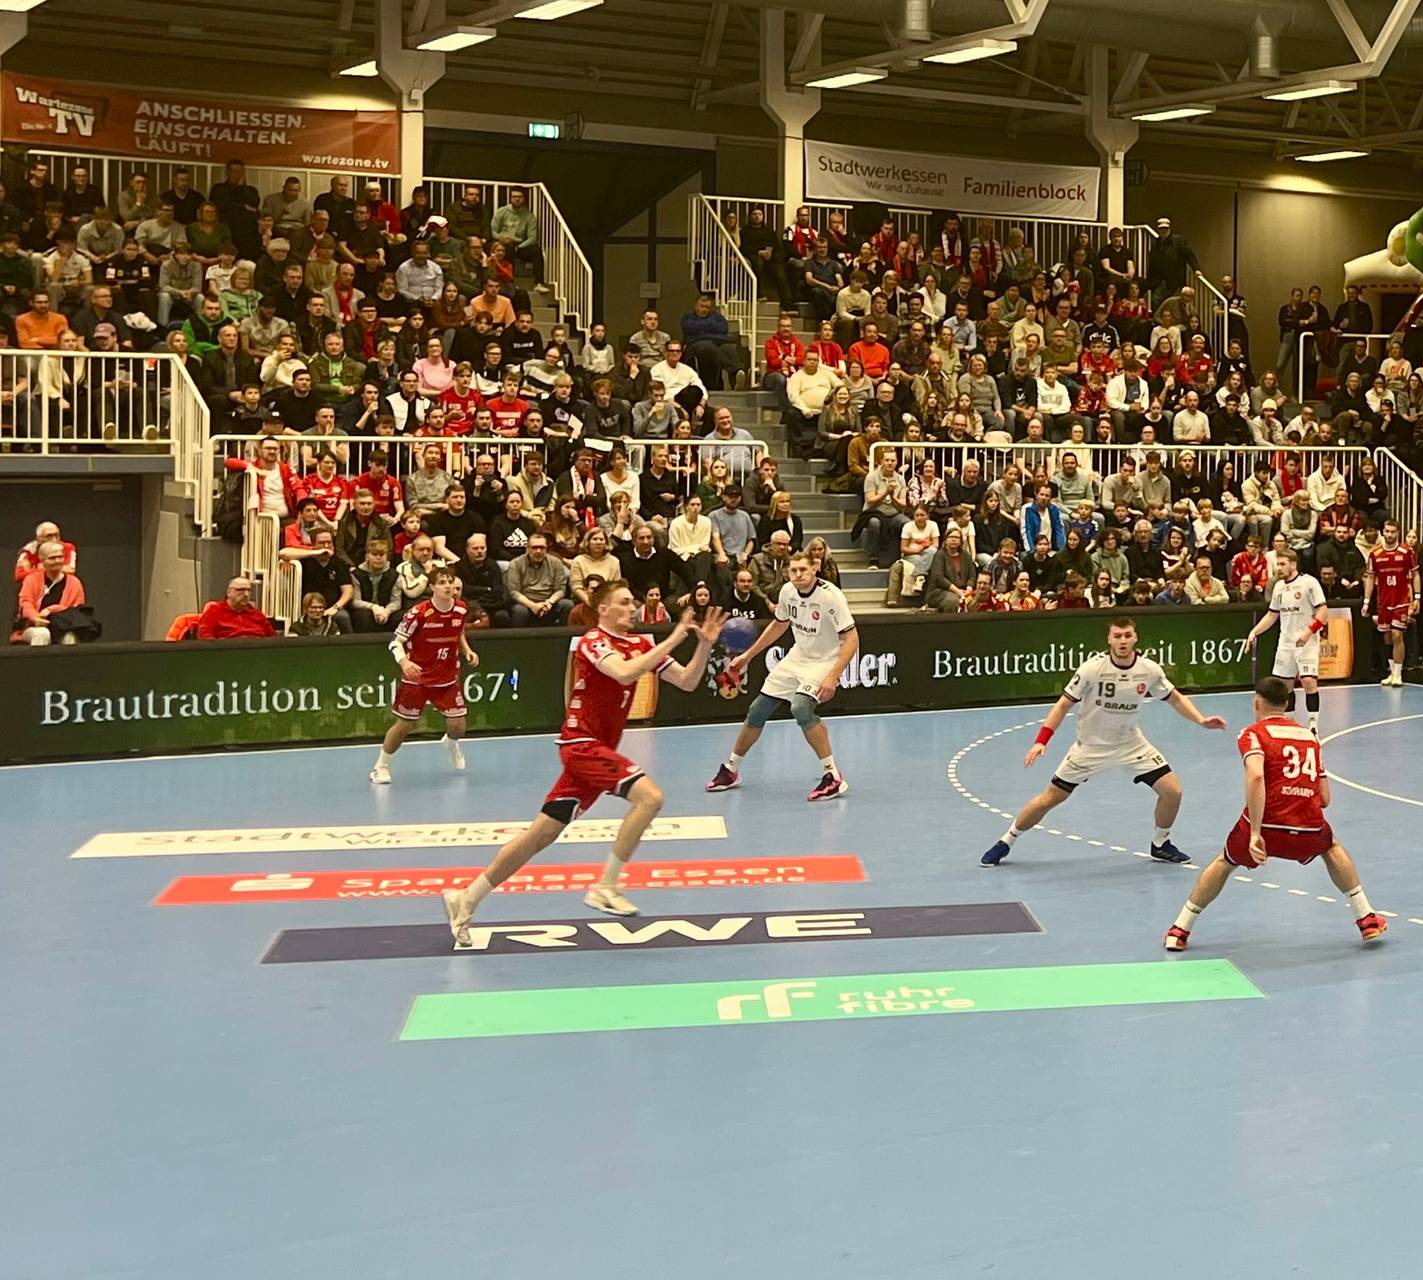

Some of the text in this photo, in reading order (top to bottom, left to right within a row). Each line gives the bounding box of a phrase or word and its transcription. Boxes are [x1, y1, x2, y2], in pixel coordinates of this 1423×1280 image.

[48, 107, 95, 137] TV
[135, 101, 307, 129] ANSCHLIESSEN.
[134, 119, 293, 146] EINSCHALTEN.
[302, 153, 390, 170] wartezone.tv
[817, 155, 948, 185] Stadtwerkessen
[963, 176, 1087, 201] Familienblock
[436, 647, 450, 660] 15
[41, 677, 322, 725] Brautradition
[1098, 681, 1116, 698] 19
[1282, 744, 1318, 782] 34
[651, 865, 805, 879] Essen
[453, 912, 872, 951] RWE
[837, 997, 976, 1014] fibre
[839, 986, 957, 1002] ruhr
